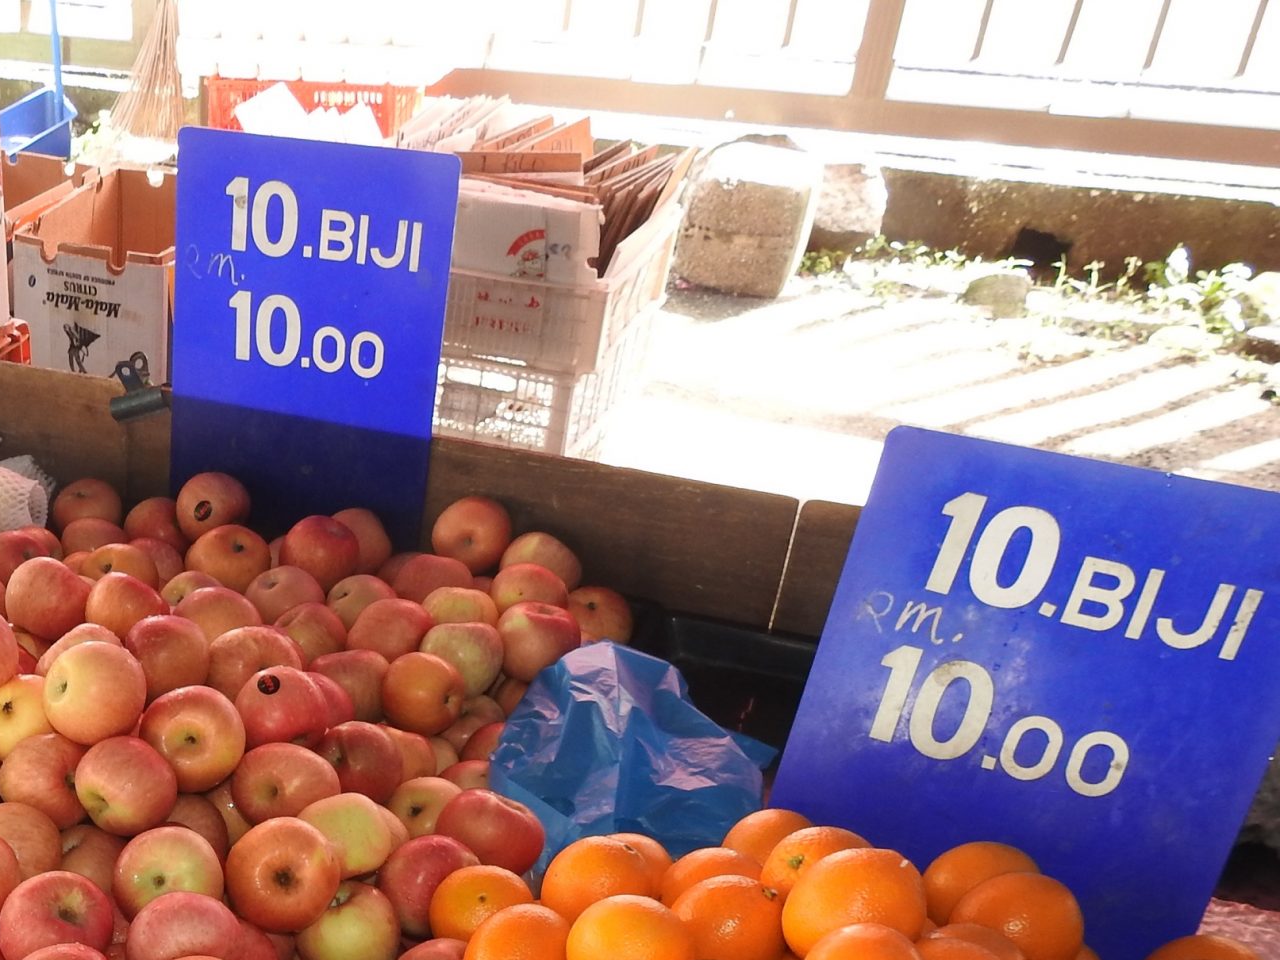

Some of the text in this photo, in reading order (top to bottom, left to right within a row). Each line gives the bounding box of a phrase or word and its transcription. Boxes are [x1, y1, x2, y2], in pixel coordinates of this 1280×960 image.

[225, 177, 423, 273] 10.BIJI
[63, 281, 98, 297] CITRUS
[229, 290, 385, 379] 10.00
[924, 491, 1265, 661] 10.BIJI
[868, 645, 1130, 797] 10.00
